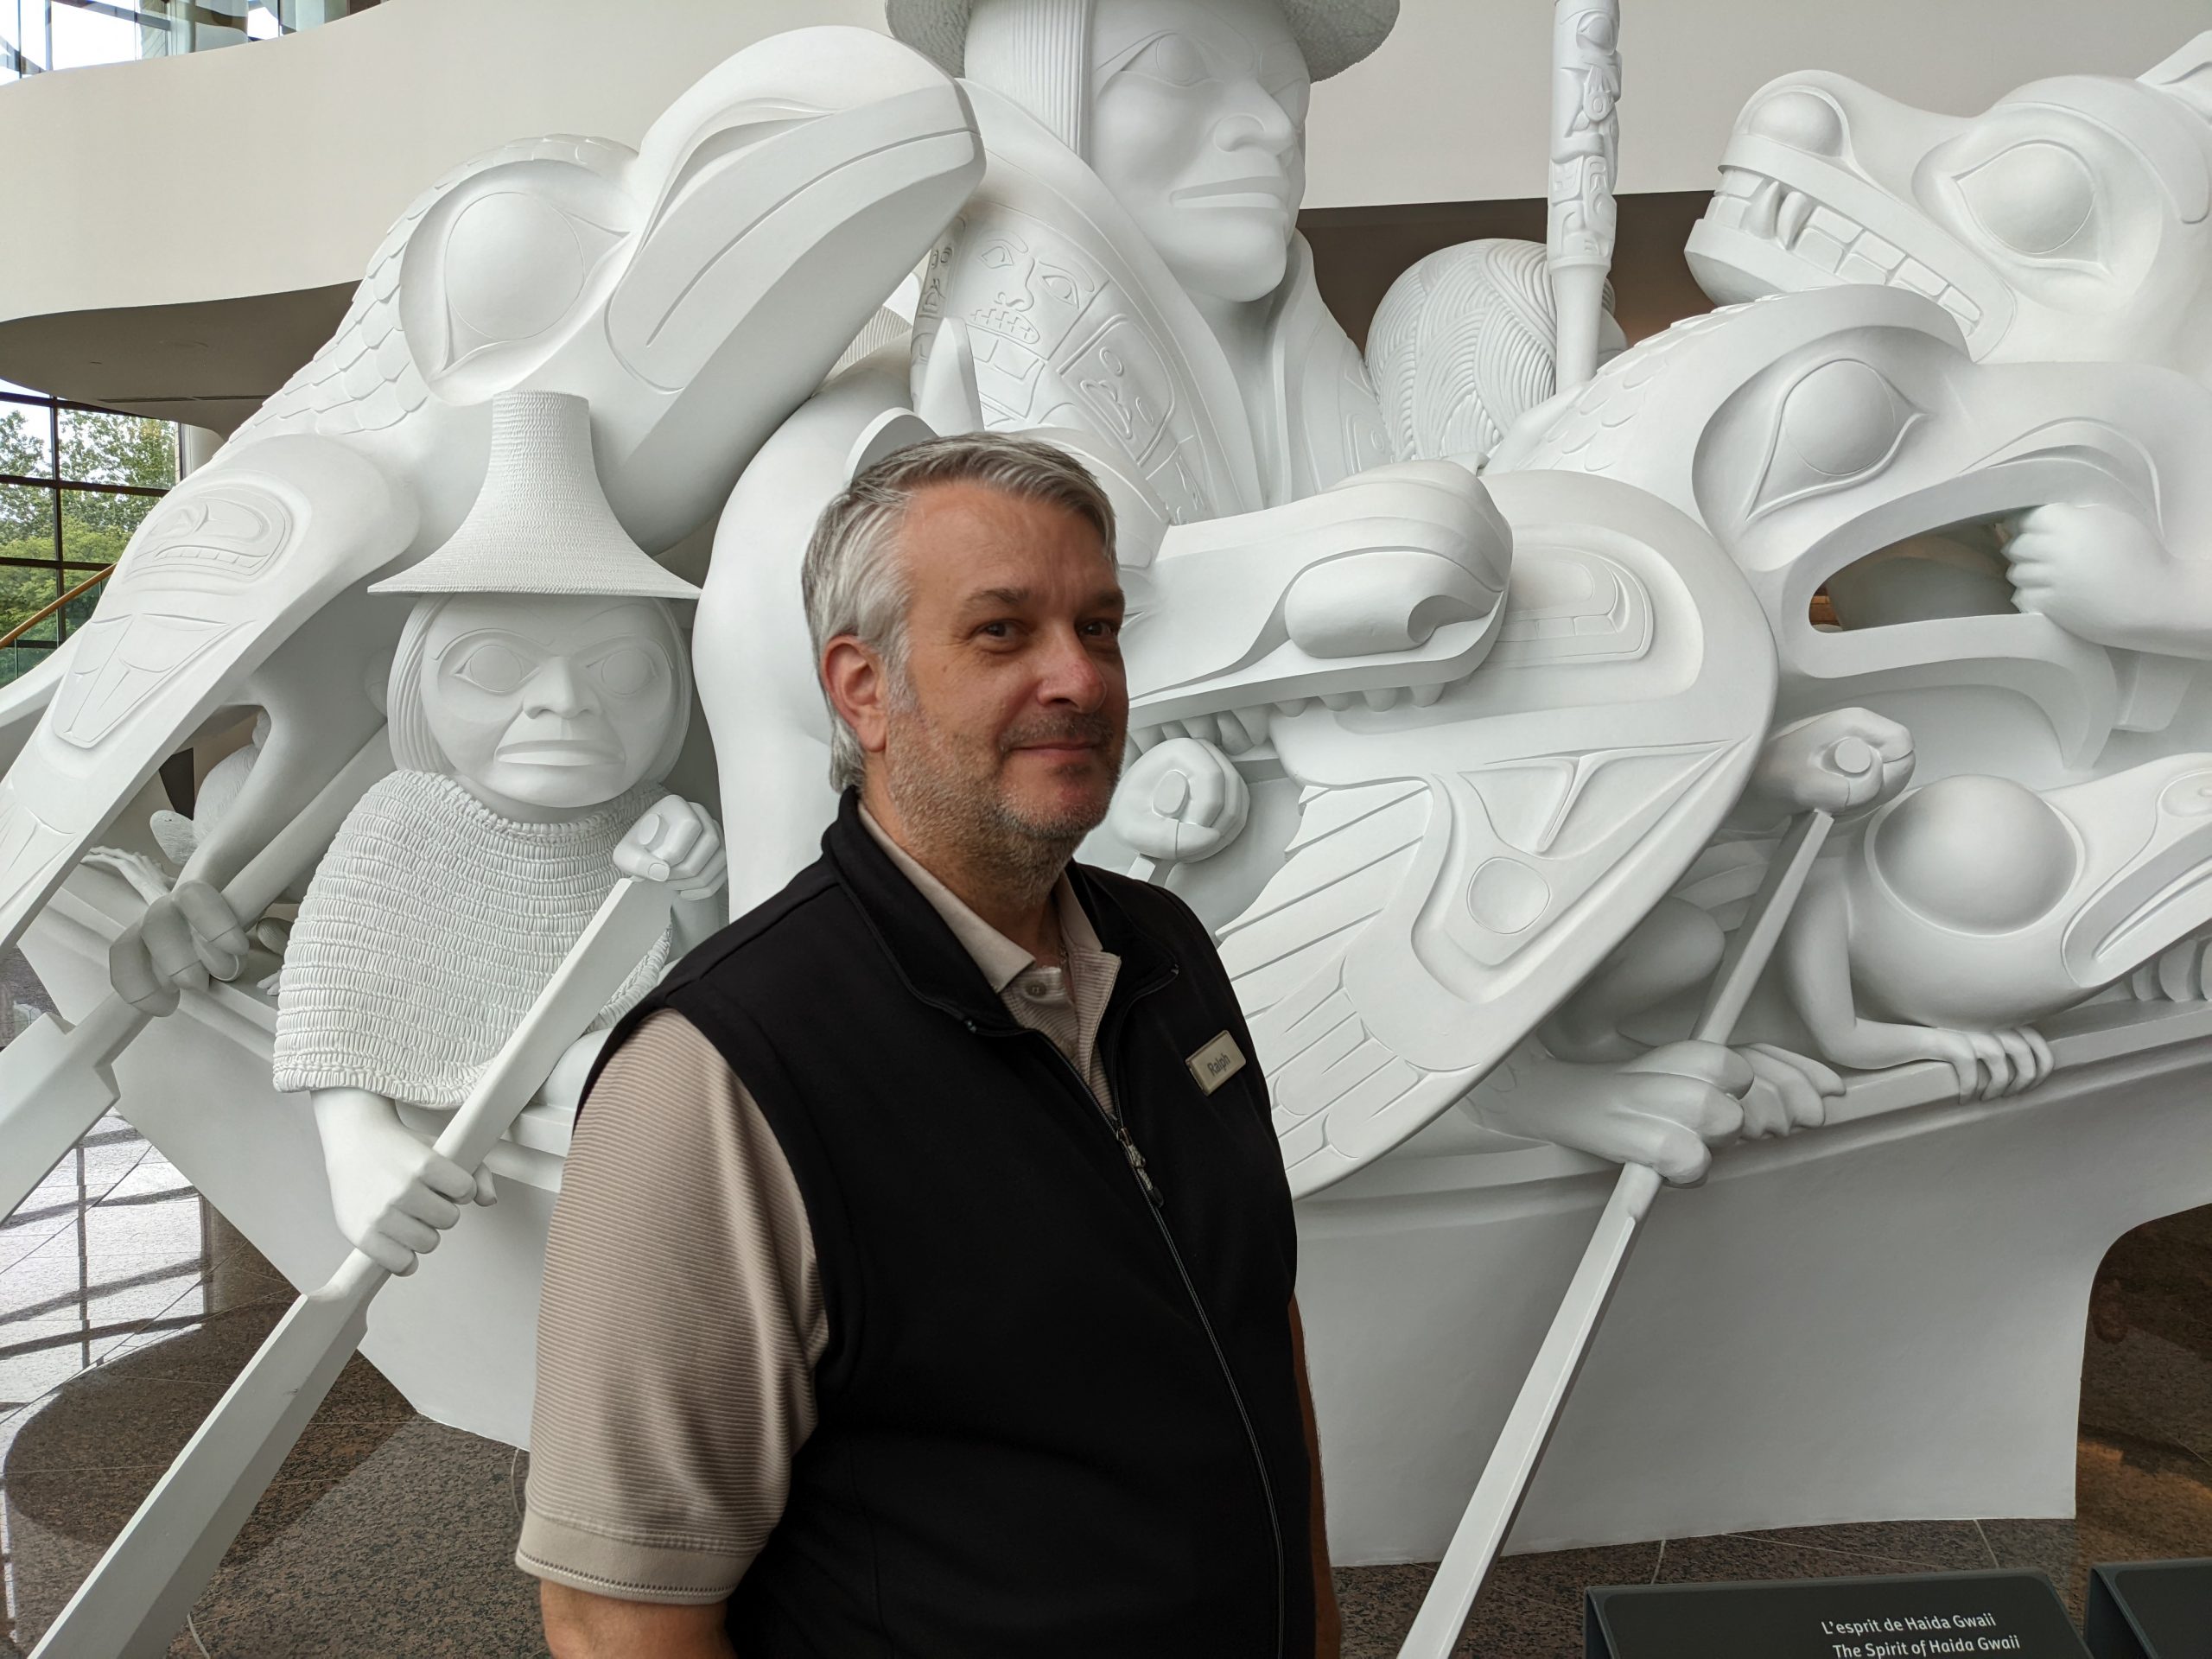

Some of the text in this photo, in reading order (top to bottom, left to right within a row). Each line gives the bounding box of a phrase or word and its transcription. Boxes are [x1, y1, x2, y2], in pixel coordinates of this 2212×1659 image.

[1207, 1052, 1231, 1077] Ralph
[1821, 1612, 1997, 1637] L'esprit de Haida Gwaii
[1832, 1634, 2020, 1659] The Spirit of Haida Gwaii
